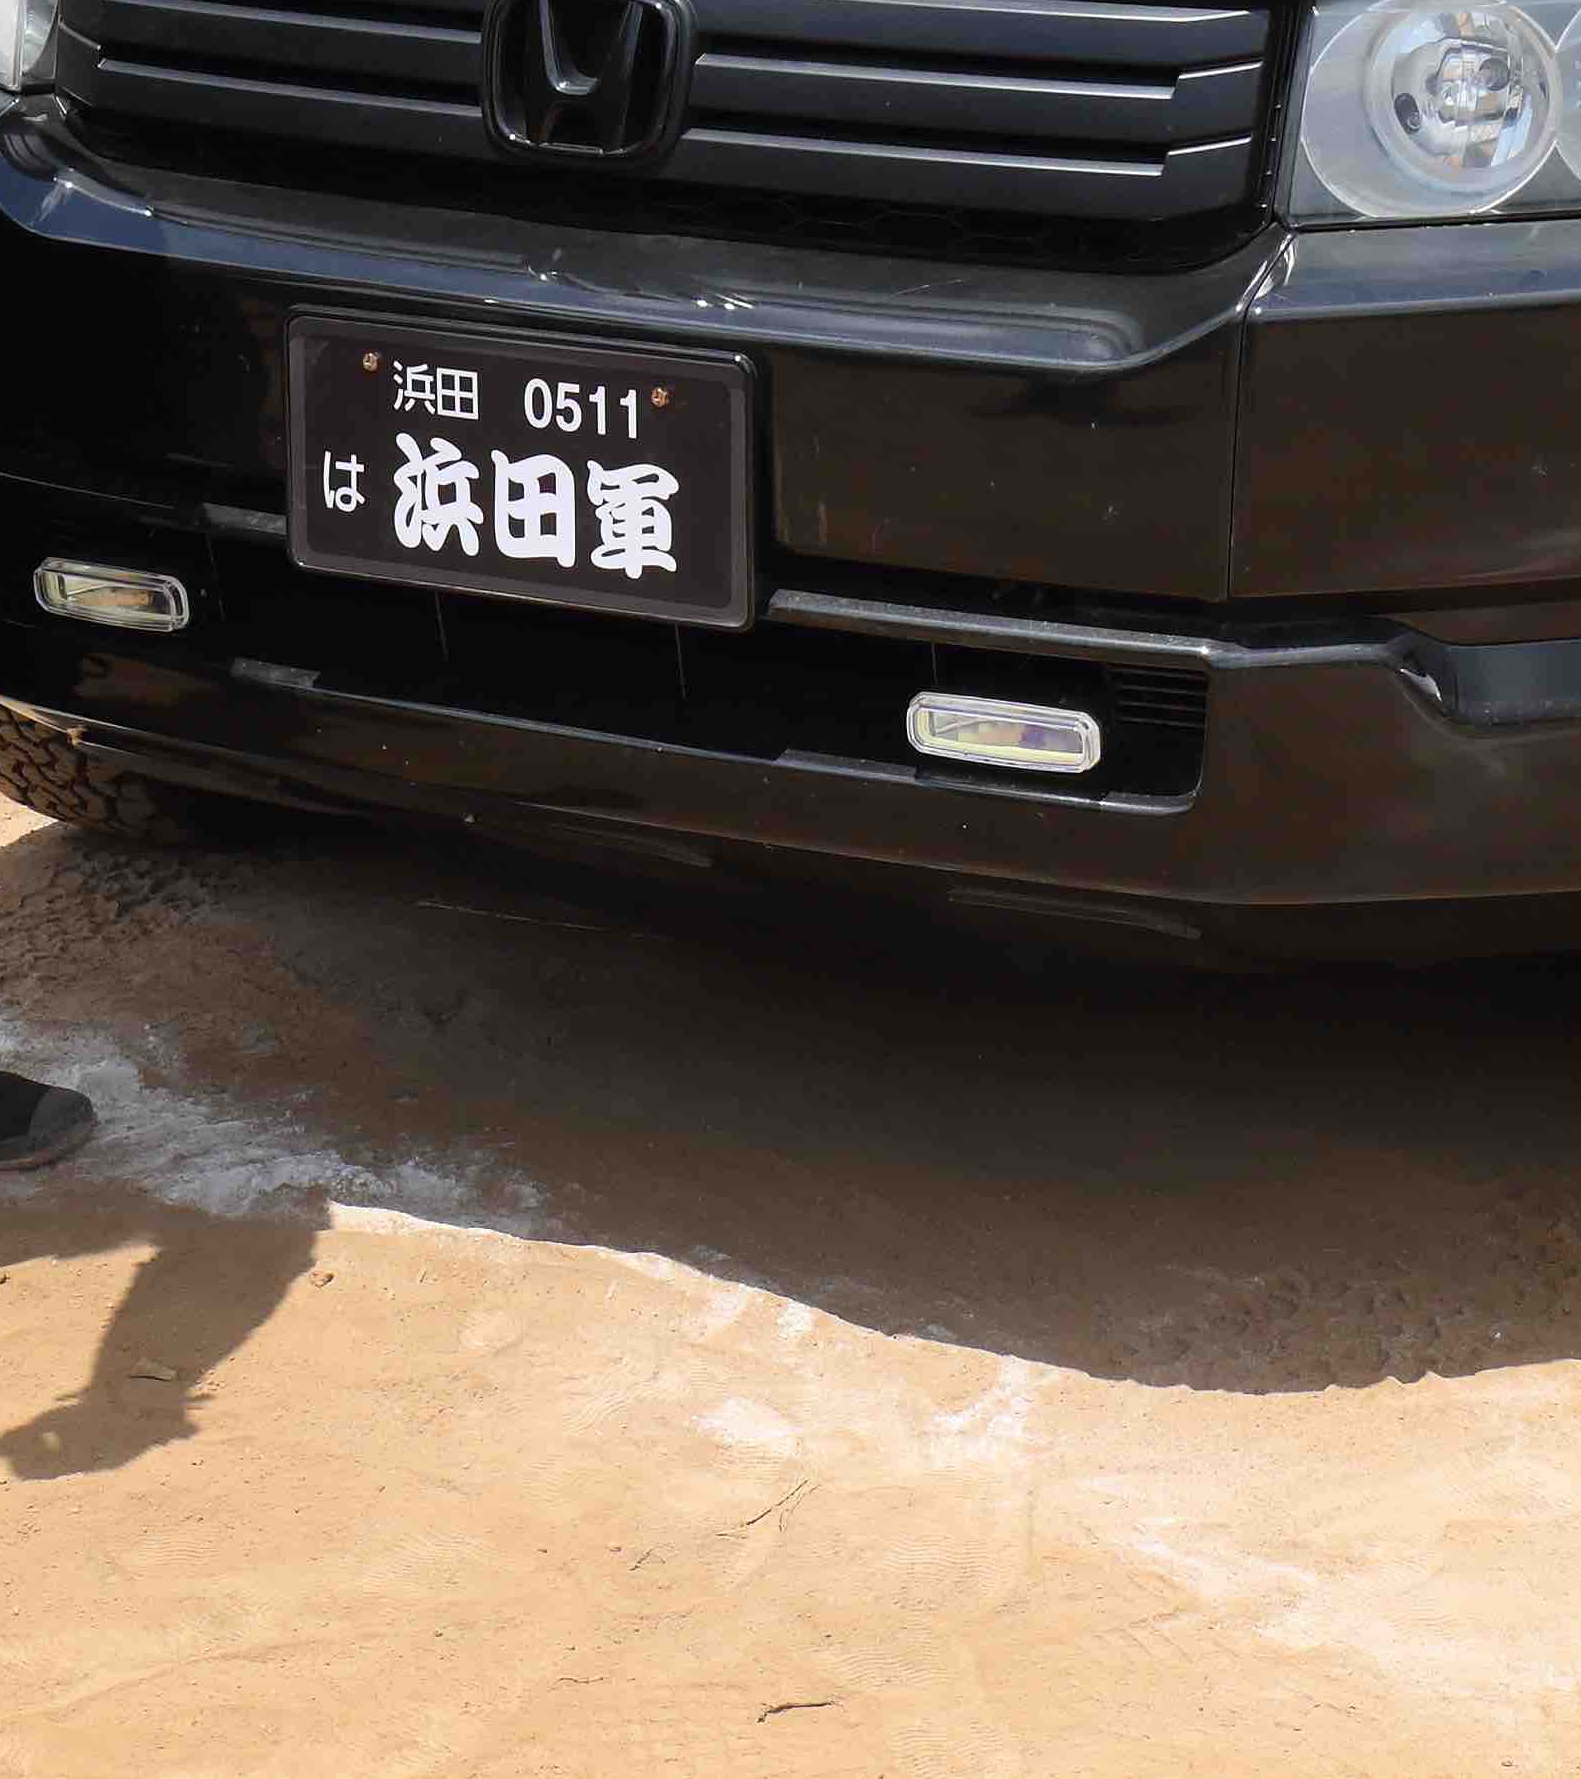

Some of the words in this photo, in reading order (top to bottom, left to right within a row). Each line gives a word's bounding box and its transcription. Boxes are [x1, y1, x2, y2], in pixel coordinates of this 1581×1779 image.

[394, 361, 478, 419] 浜田
[525, 379, 636, 438] 0511
[324, 451, 365, 512] は
[394, 432, 679, 579] 浜田軍
